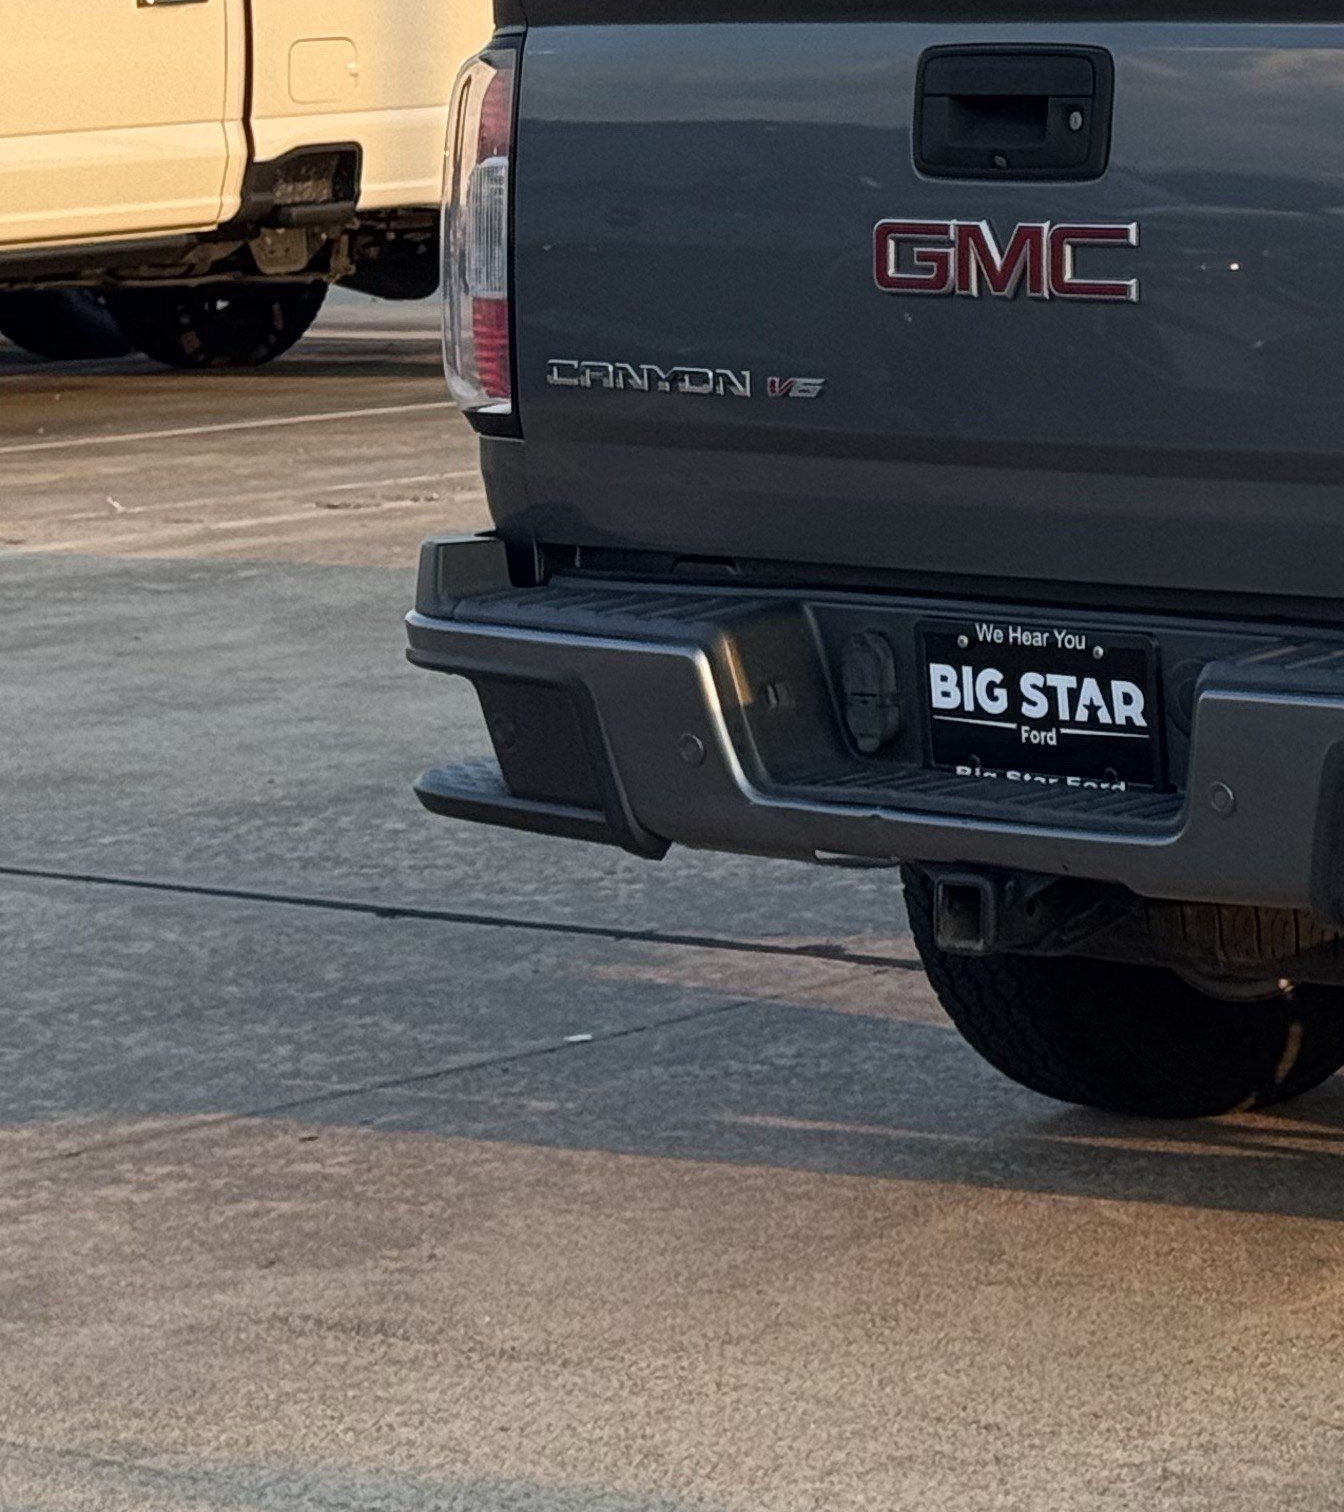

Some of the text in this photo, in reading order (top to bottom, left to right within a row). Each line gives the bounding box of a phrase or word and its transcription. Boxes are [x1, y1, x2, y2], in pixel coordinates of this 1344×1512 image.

[873, 218, 1140, 303] GMC
[547, 359, 826, 398] CANYON V6
[975, 623, 1086, 650] We Hear You
[929, 662, 1148, 727] BIG STAR
[1021, 725, 1058, 746] Ford
